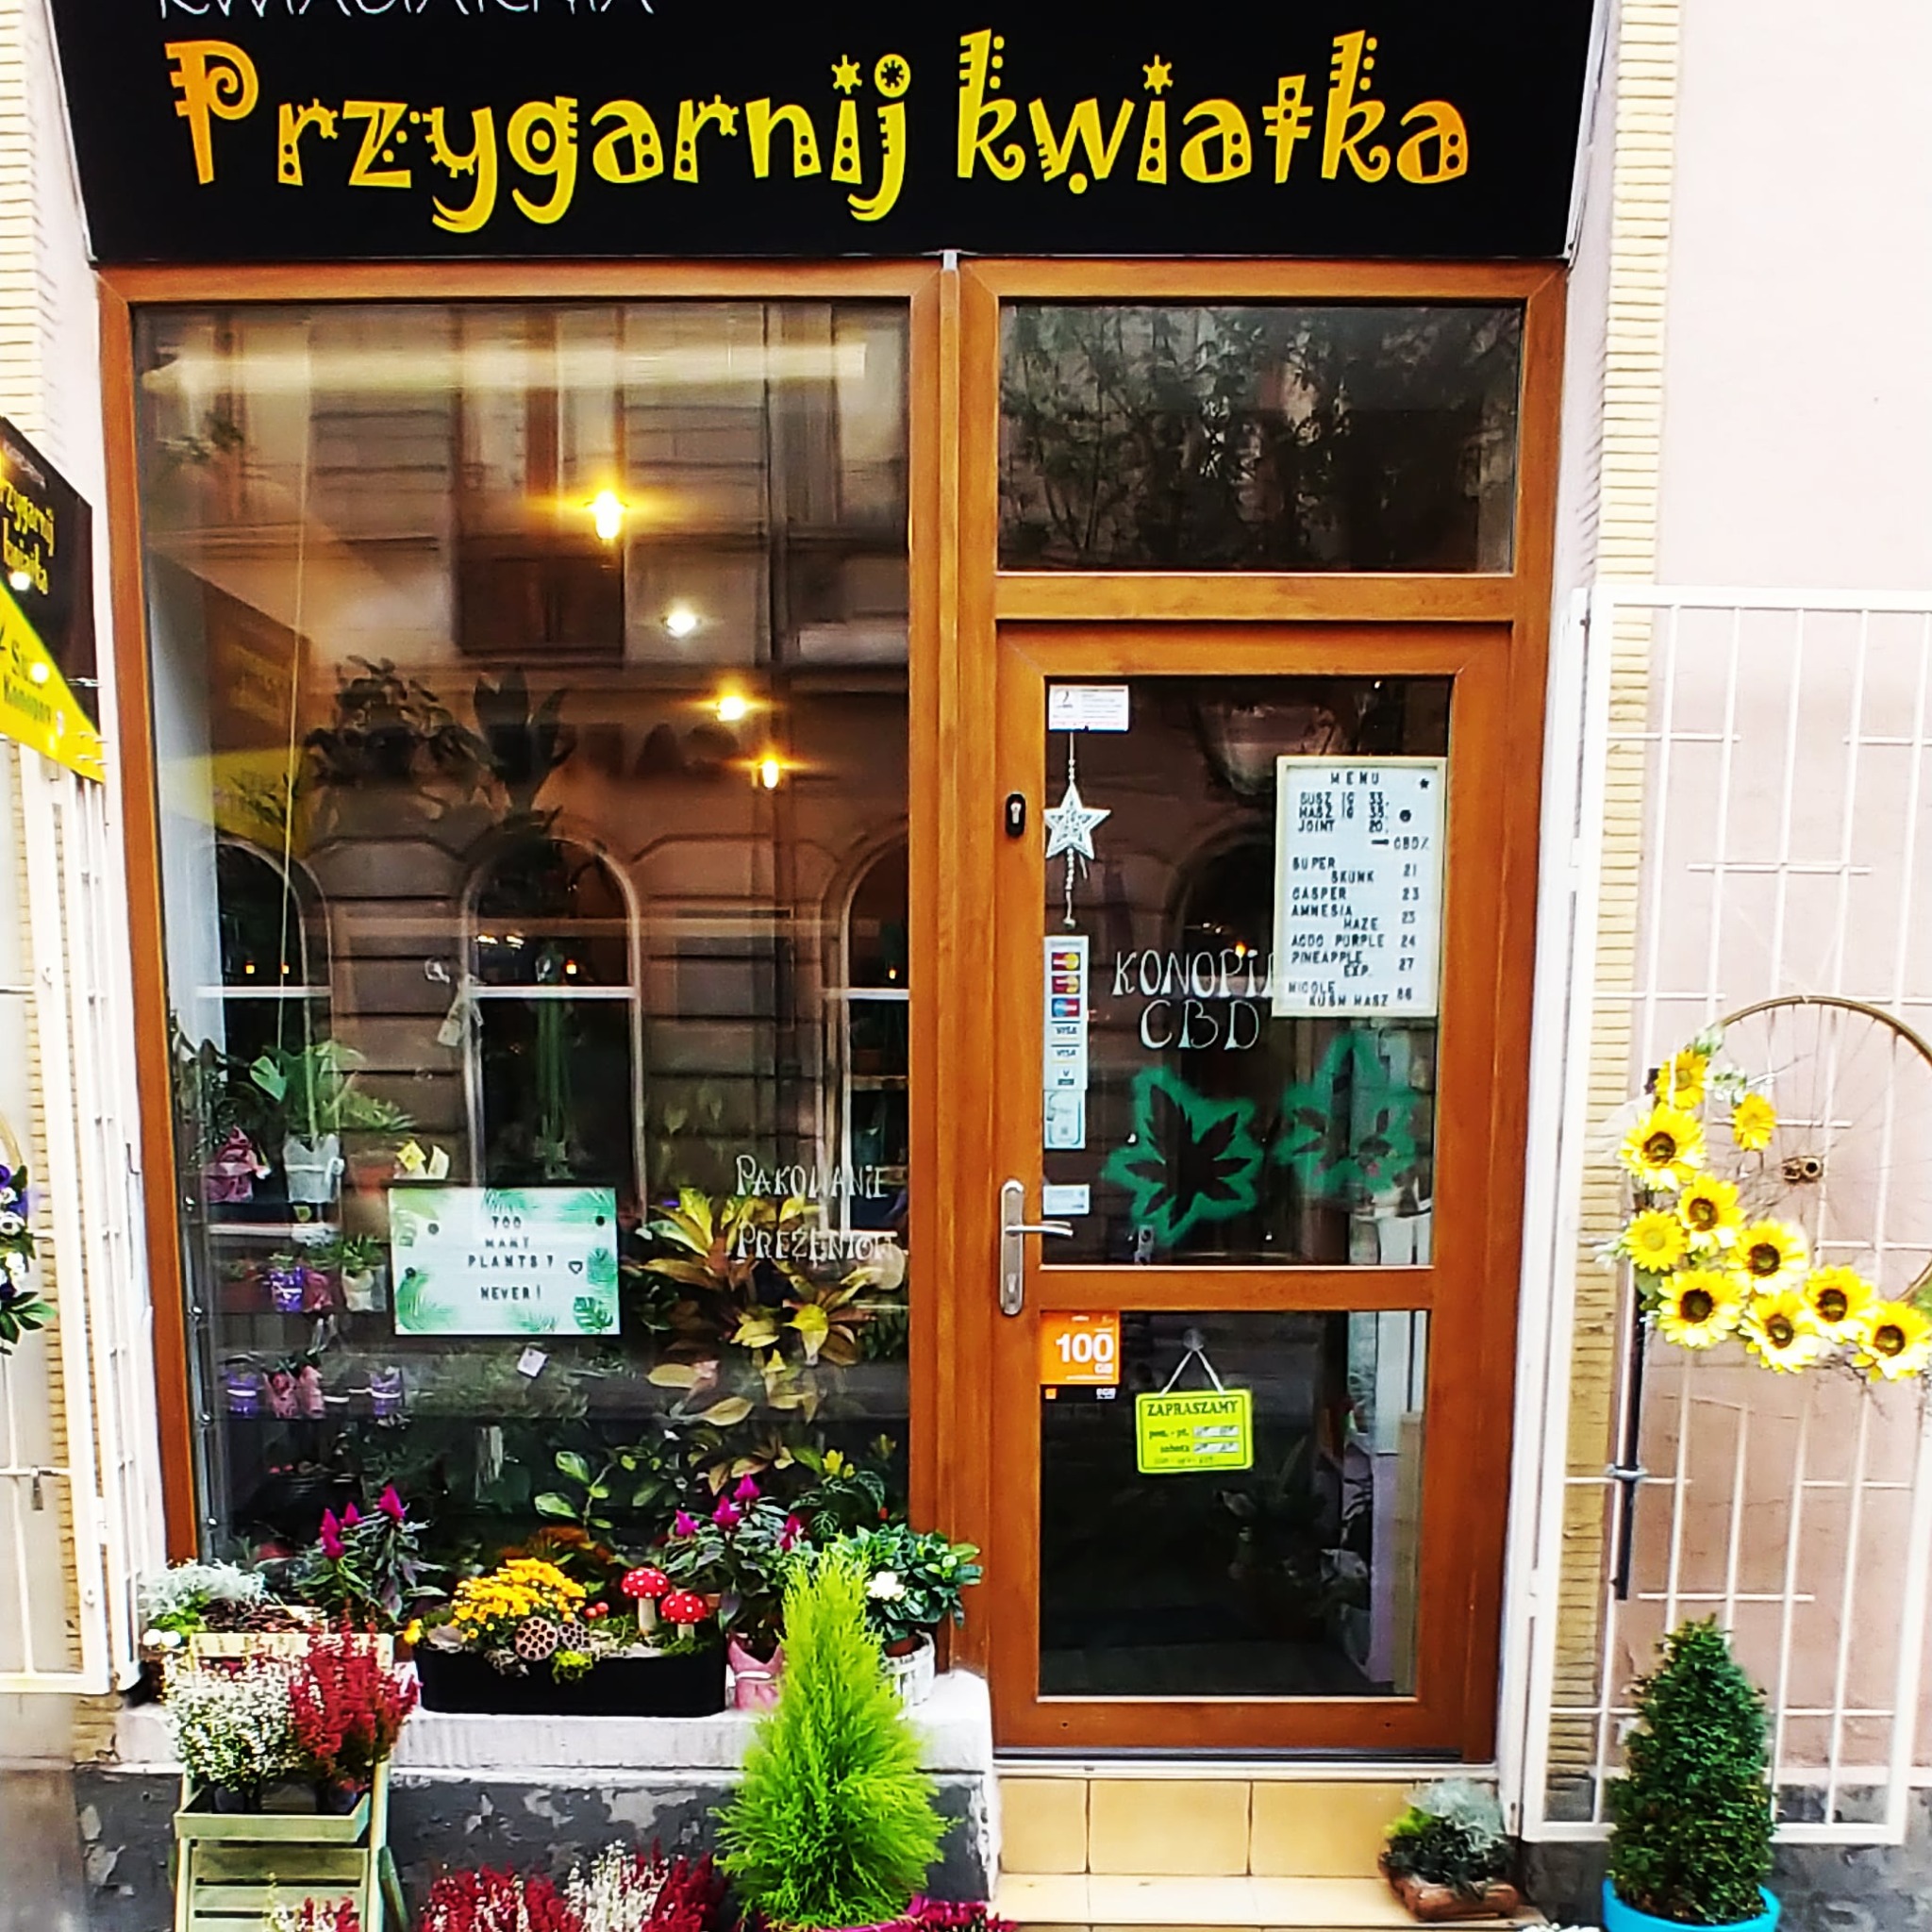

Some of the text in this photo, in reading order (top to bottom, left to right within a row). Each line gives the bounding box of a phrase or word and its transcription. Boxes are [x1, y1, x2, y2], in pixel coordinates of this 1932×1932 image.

[163, 28, 1469, 234] Przygarnij kwiatka
[1330, 771, 1380, 785] MENU
[1298, 820, 1335, 833] JOINT
[1292, 857, 1336, 870] SUPER
[1331, 870, 1374, 884] SKUNK
[1291, 904, 1353, 917] AMNESIA
[1343, 917, 1379, 931] HAZE
[1335, 934, 1385, 948] PURPLE
[1291, 951, 1363, 964] PINEAPPLE
[1140, 999, 1260, 1050] CBD
[1056, 1332, 1115, 1363] 100
[1147, 1400, 1239, 1417] ZAPRASZAMY
